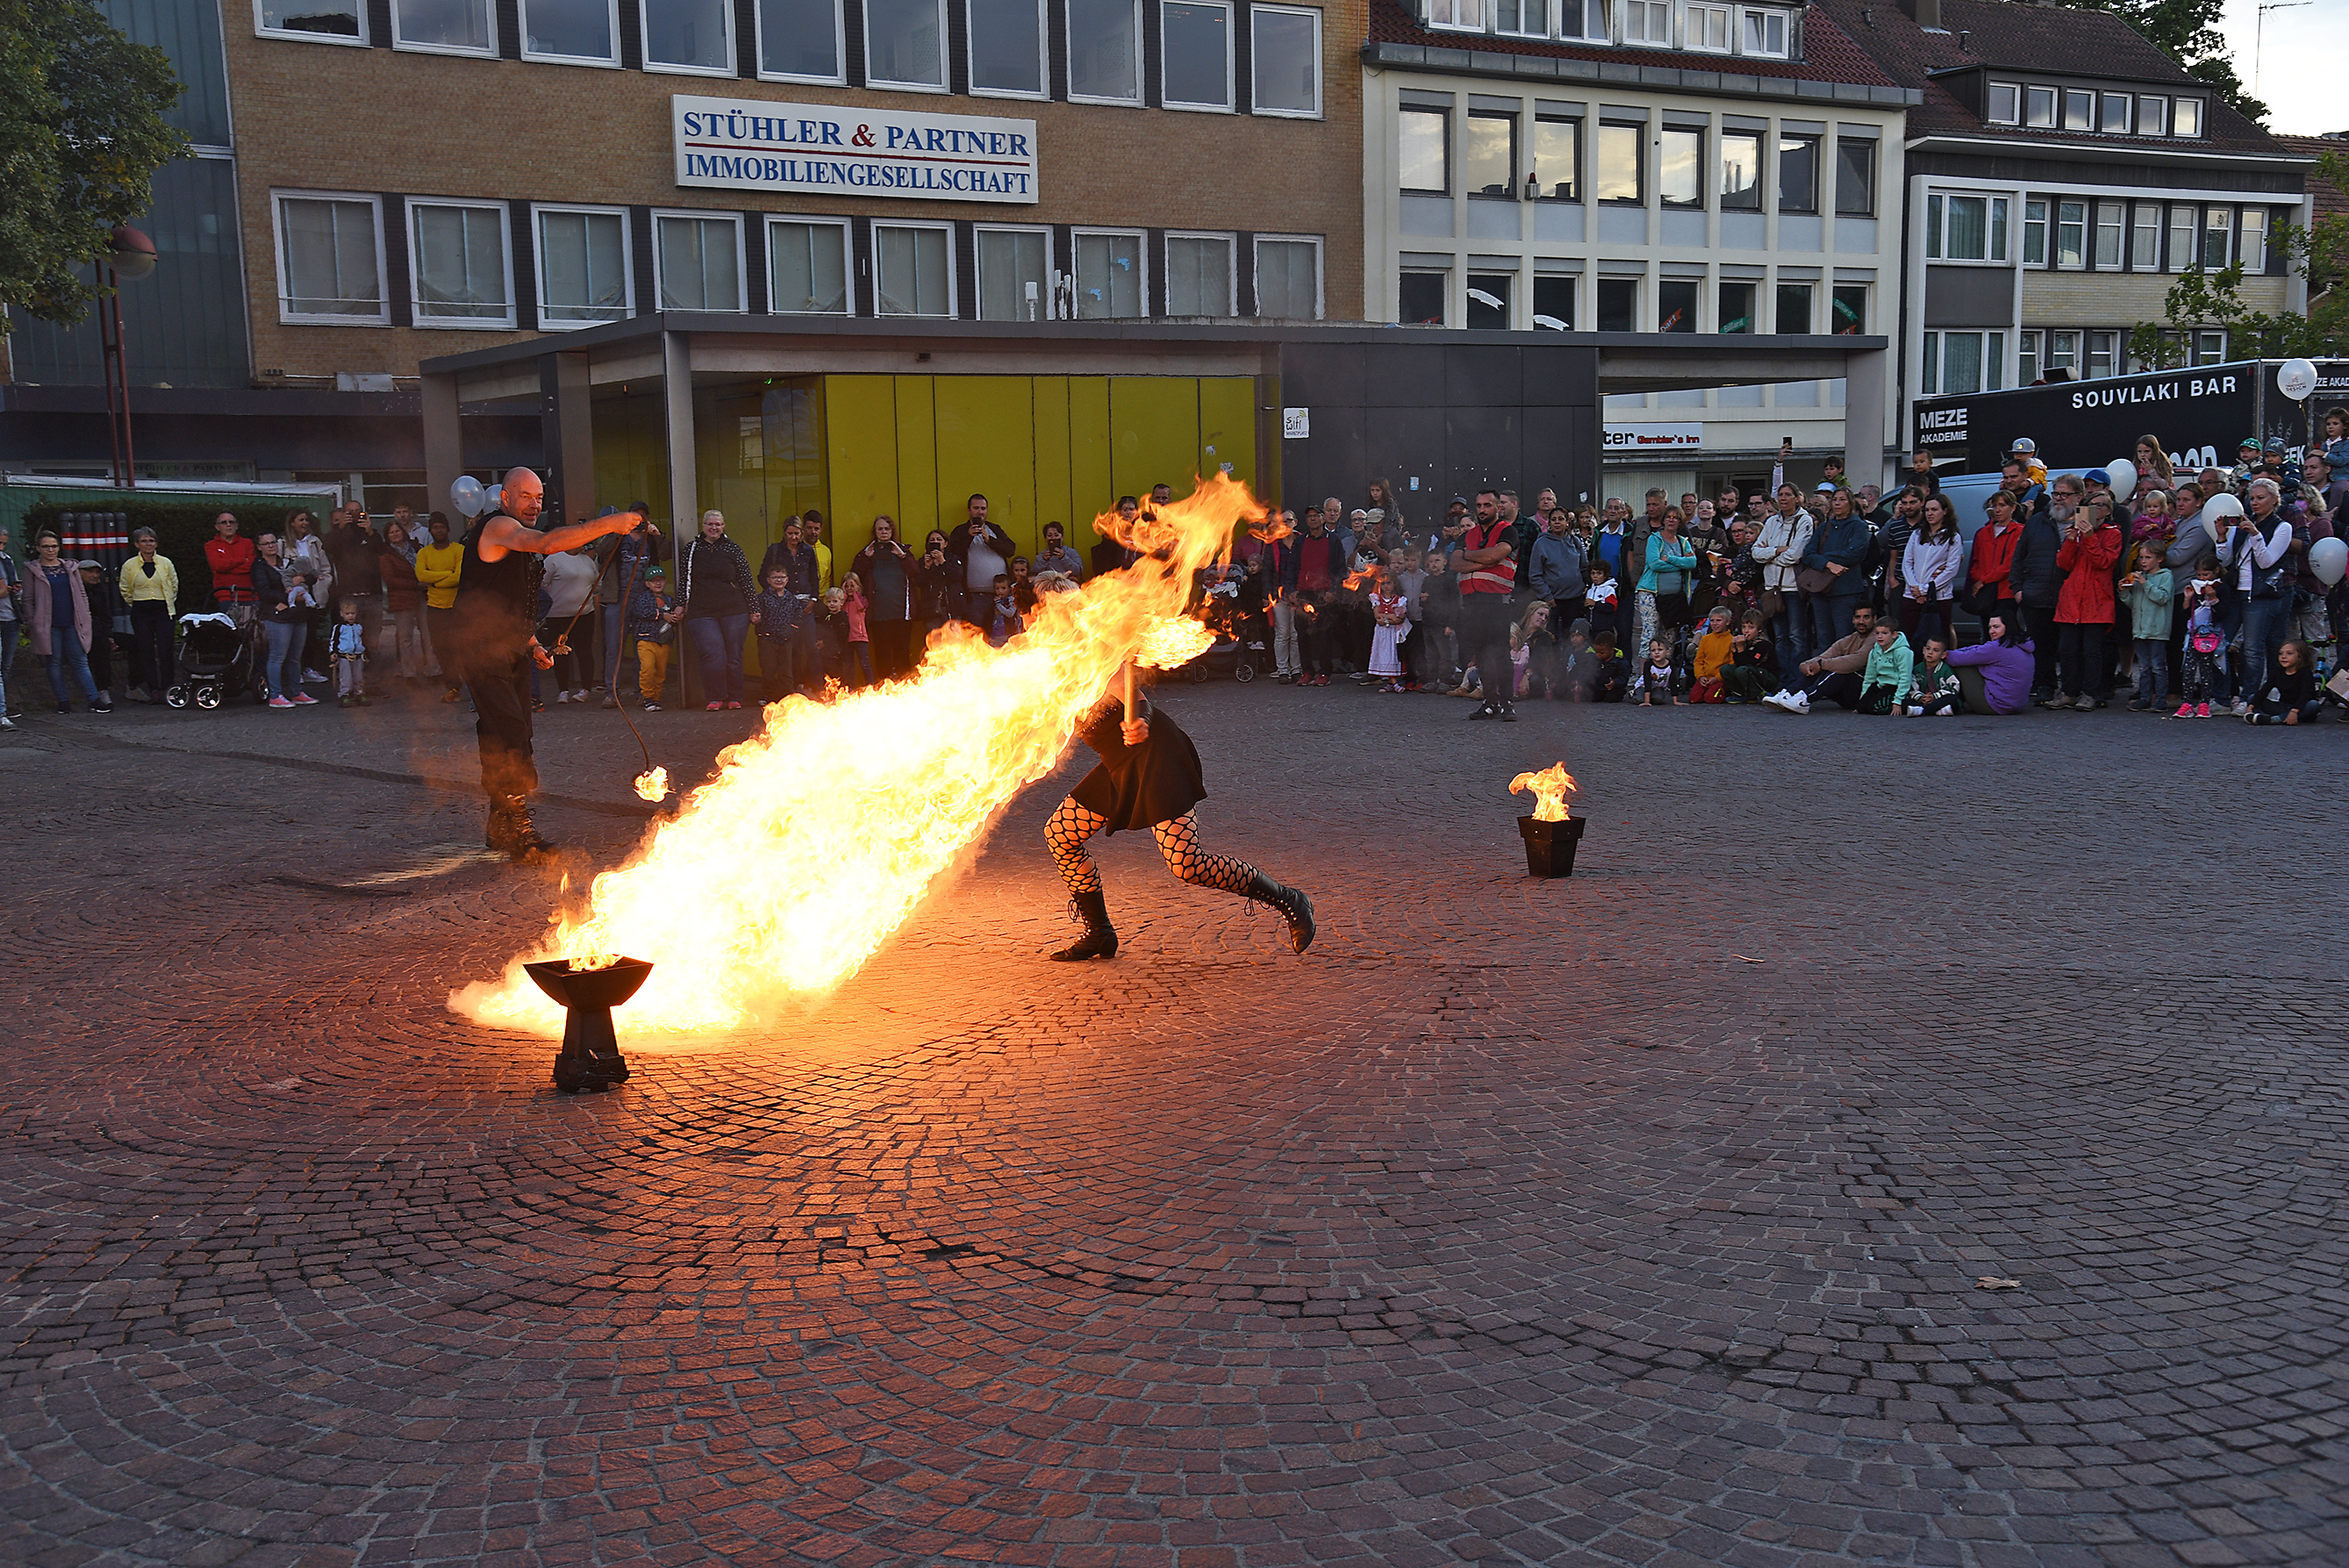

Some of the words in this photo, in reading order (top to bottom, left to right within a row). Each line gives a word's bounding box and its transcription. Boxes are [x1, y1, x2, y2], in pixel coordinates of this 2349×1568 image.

[683, 109, 843, 147] STÜHLER
[851, 124, 877, 147] &
[884, 125, 1030, 156] PARTNER
[685, 154, 1030, 194] IMMOBILIENGESELLSCHAFT
[1660, 314, 1677, 333] Dart
[1723, 319, 1744, 333] Billard
[2316, 377, 2328, 386] ZE
[2072, 382, 2179, 409] SOUVLAKI
[2190, 376, 2237, 397] BAR
[1920, 408, 1967, 429] MEZE
[1686, 435, 1700, 444] Inn
